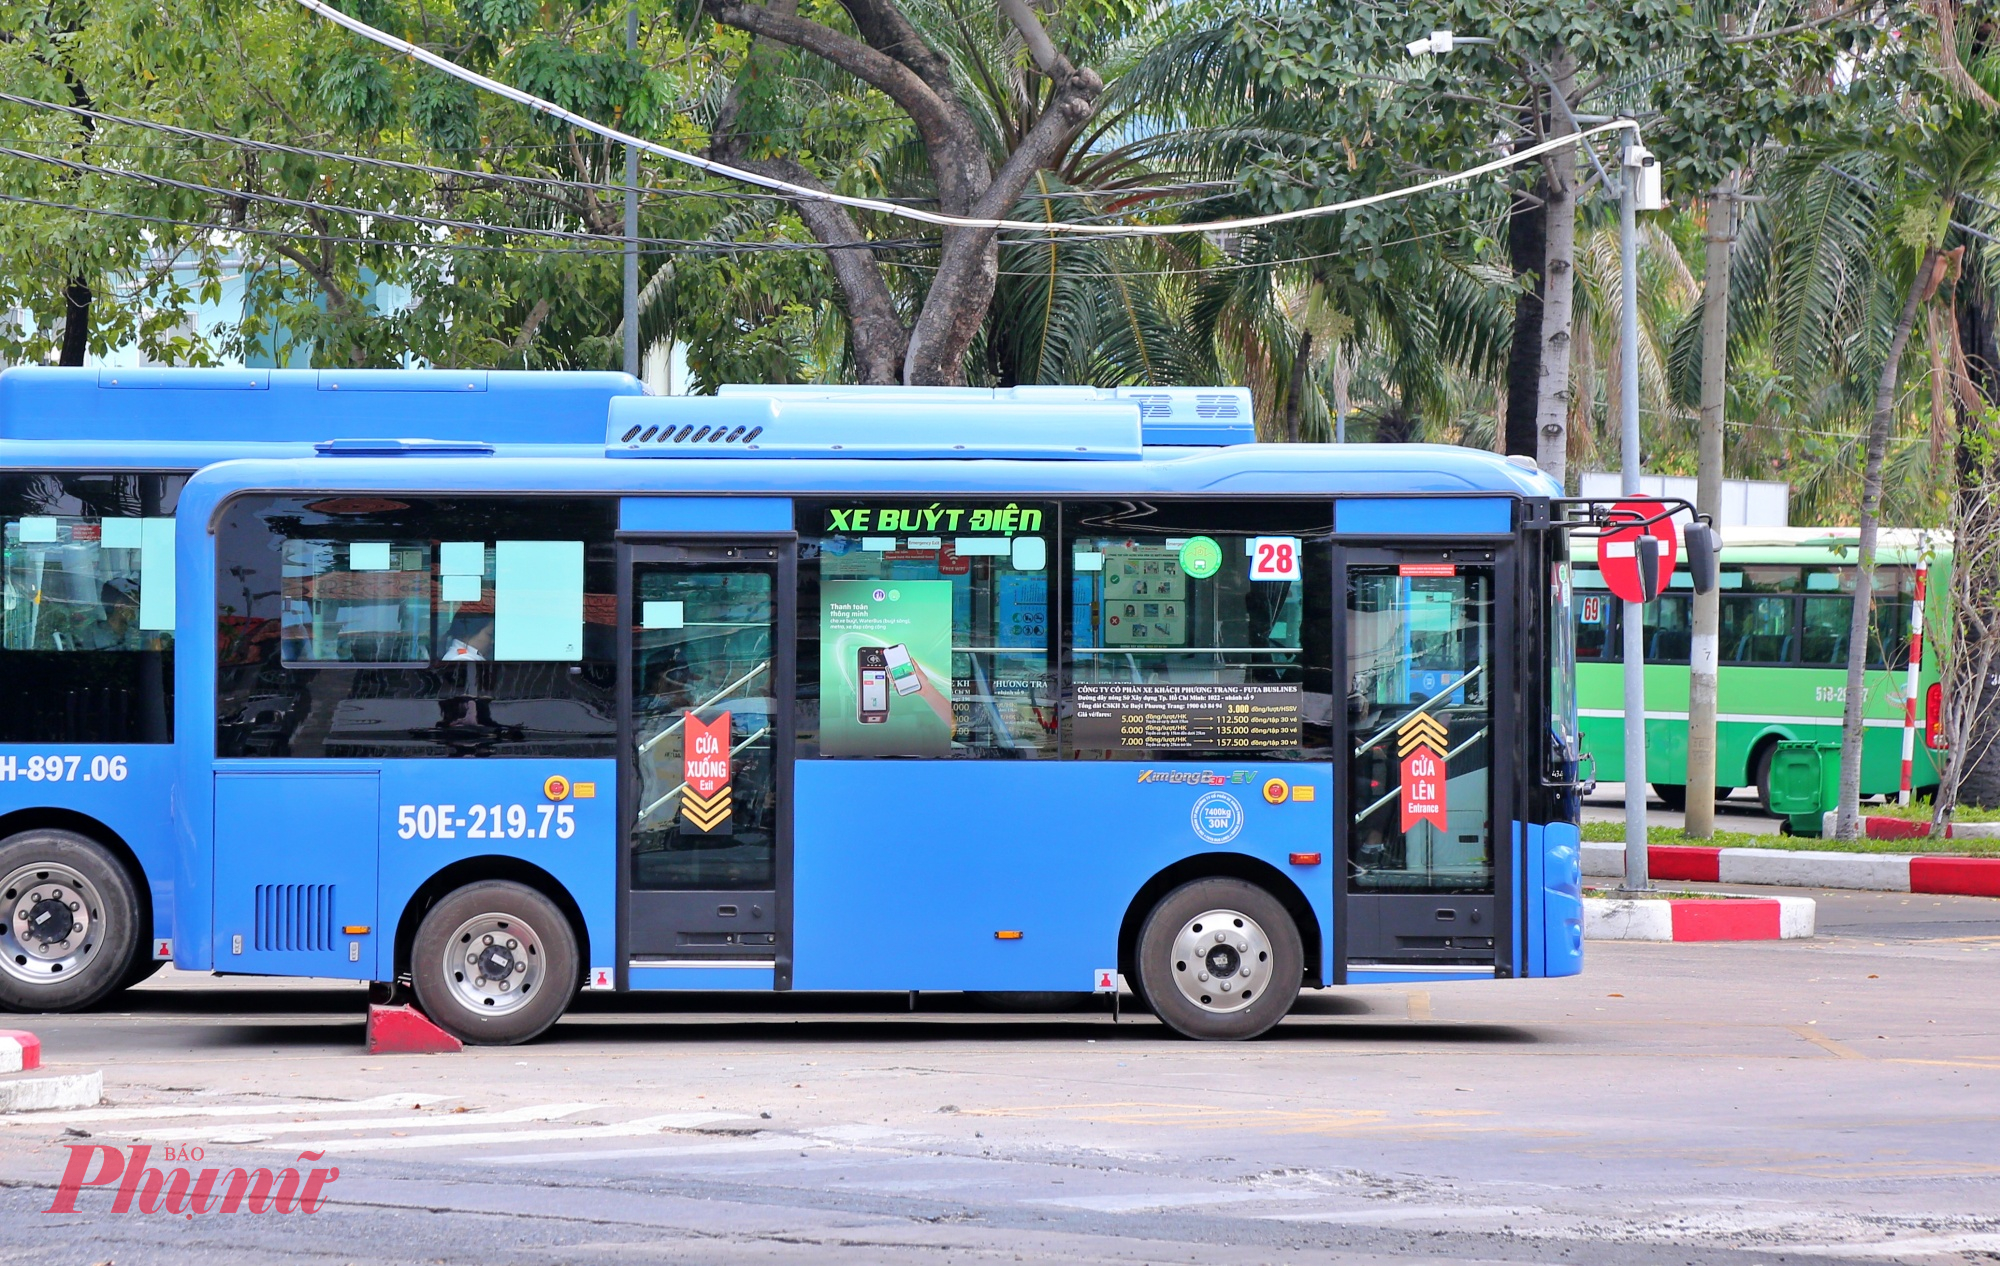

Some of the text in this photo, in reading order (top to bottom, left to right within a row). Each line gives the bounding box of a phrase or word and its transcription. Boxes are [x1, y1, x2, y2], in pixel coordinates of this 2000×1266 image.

[826, 502, 1042, 536] XE BUÝT ĐIỆN
[1258, 544, 1293, 573] 28
[1584, 597, 1599, 621] 69
[1704, 652, 1711, 660] 7
[1077, 685, 1098, 693] CÔNG
[1154, 685, 1180, 693] KHÁCH
[1227, 704, 1249, 713] 3.000
[1121, 715, 1144, 723] 5.000
[1145, 713, 1187, 721] đồng/lượt/HK
[1216, 715, 1249, 724] 112.500
[1251, 716, 1279, 724] đồng/tập
[1121, 726, 1144, 734] 6.000
[1145, 724, 1187, 732] đồng/lượt/HK
[1216, 726, 1249, 734] 135.000
[1251, 727, 1279, 735] đồng/tập
[695, 732, 719, 754] CỬA
[1145, 736, 1187, 744] đồng/lượt/HK
[1216, 738, 1249, 747] 157.500
[1251, 739, 1279, 747] đồng/tập
[687, 755, 727, 778] XUỐNG
[1411, 754, 1435, 776] CỬA
[700, 779, 713, 791] Exit
[1411, 780, 1435, 800] LÊN
[1204, 808, 1231, 818] 7400kg
[1408, 802, 1439, 814] Entrance
[397, 803, 575, 839] 50E-219.75
[1208, 819, 1228, 828] 30N
